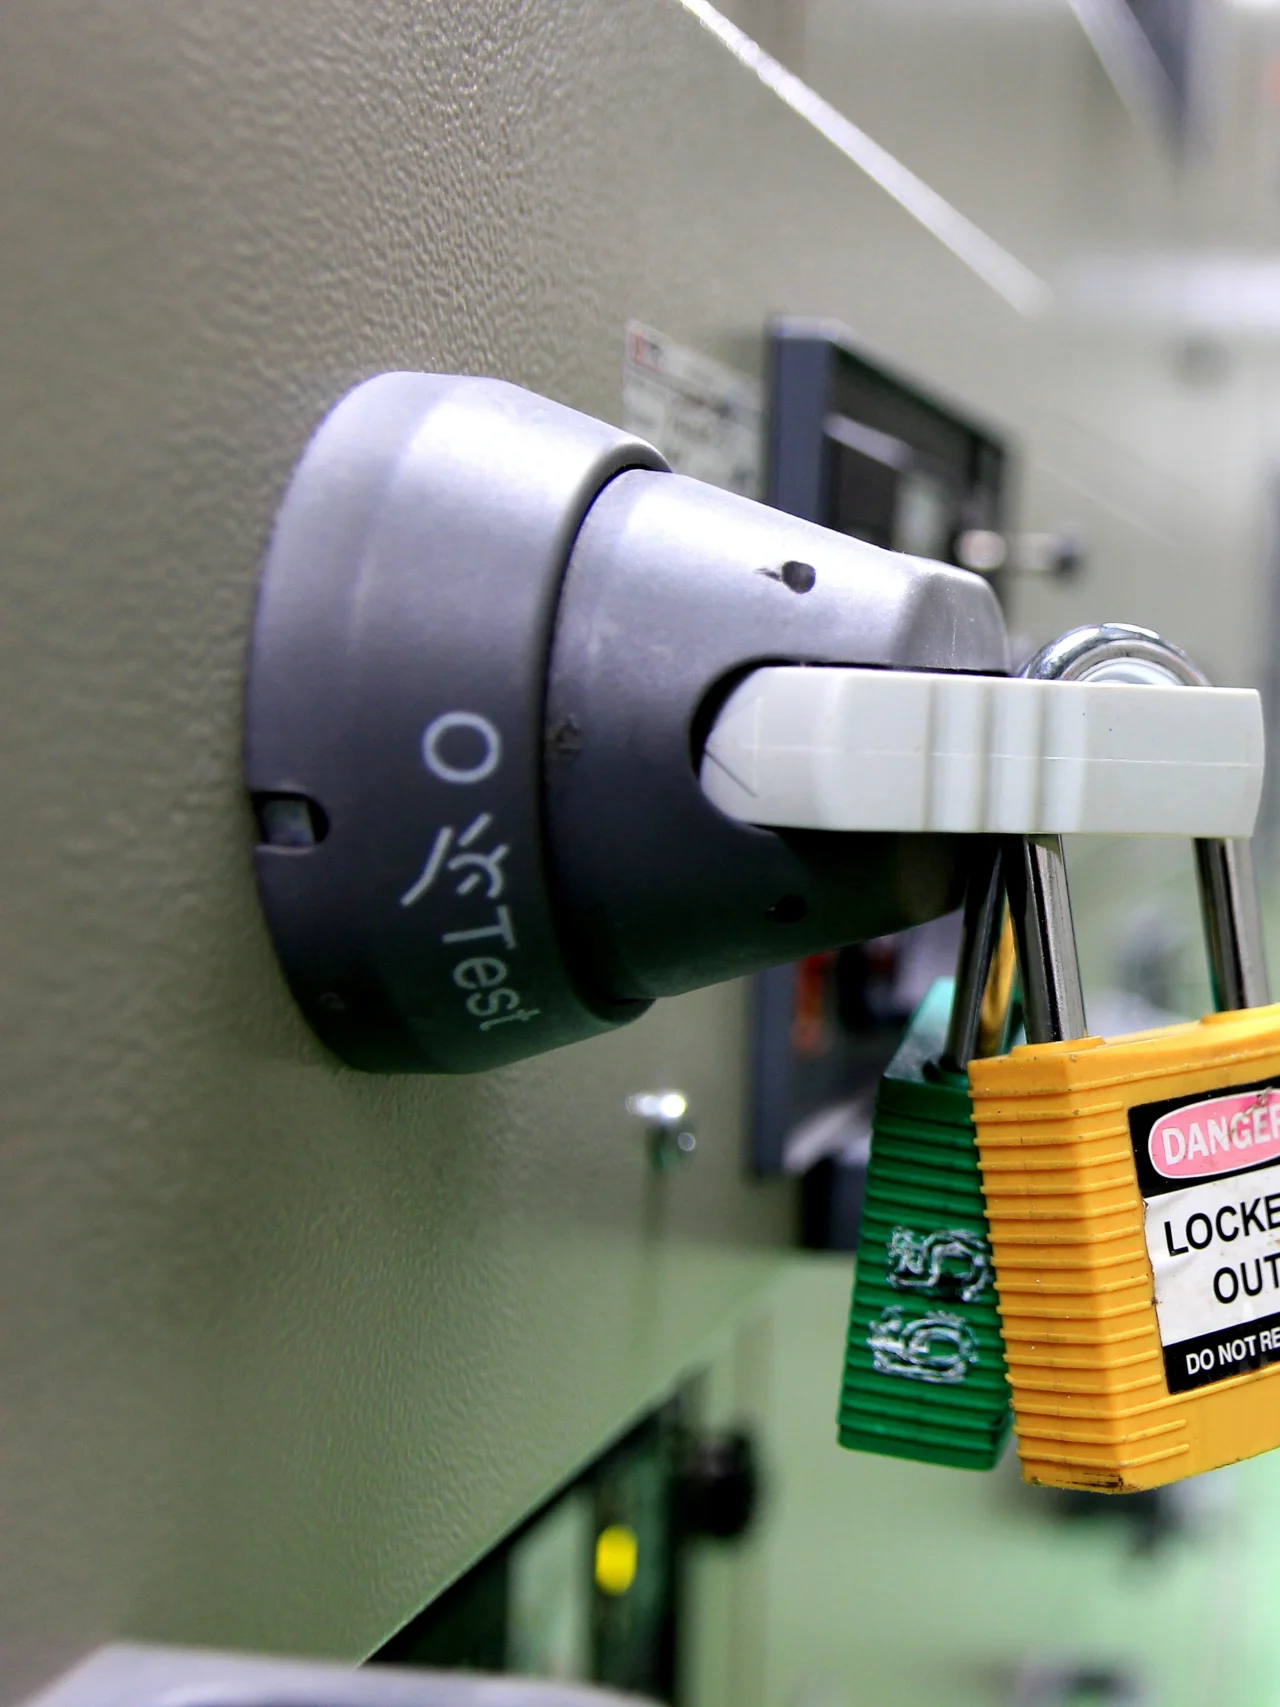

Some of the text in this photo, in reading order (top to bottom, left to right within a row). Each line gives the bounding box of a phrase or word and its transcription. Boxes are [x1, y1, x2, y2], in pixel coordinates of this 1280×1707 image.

[442, 904, 541, 1032] Test
[1185, 1348, 1215, 1375] DO
[1219, 1335, 1257, 1366] NOT
